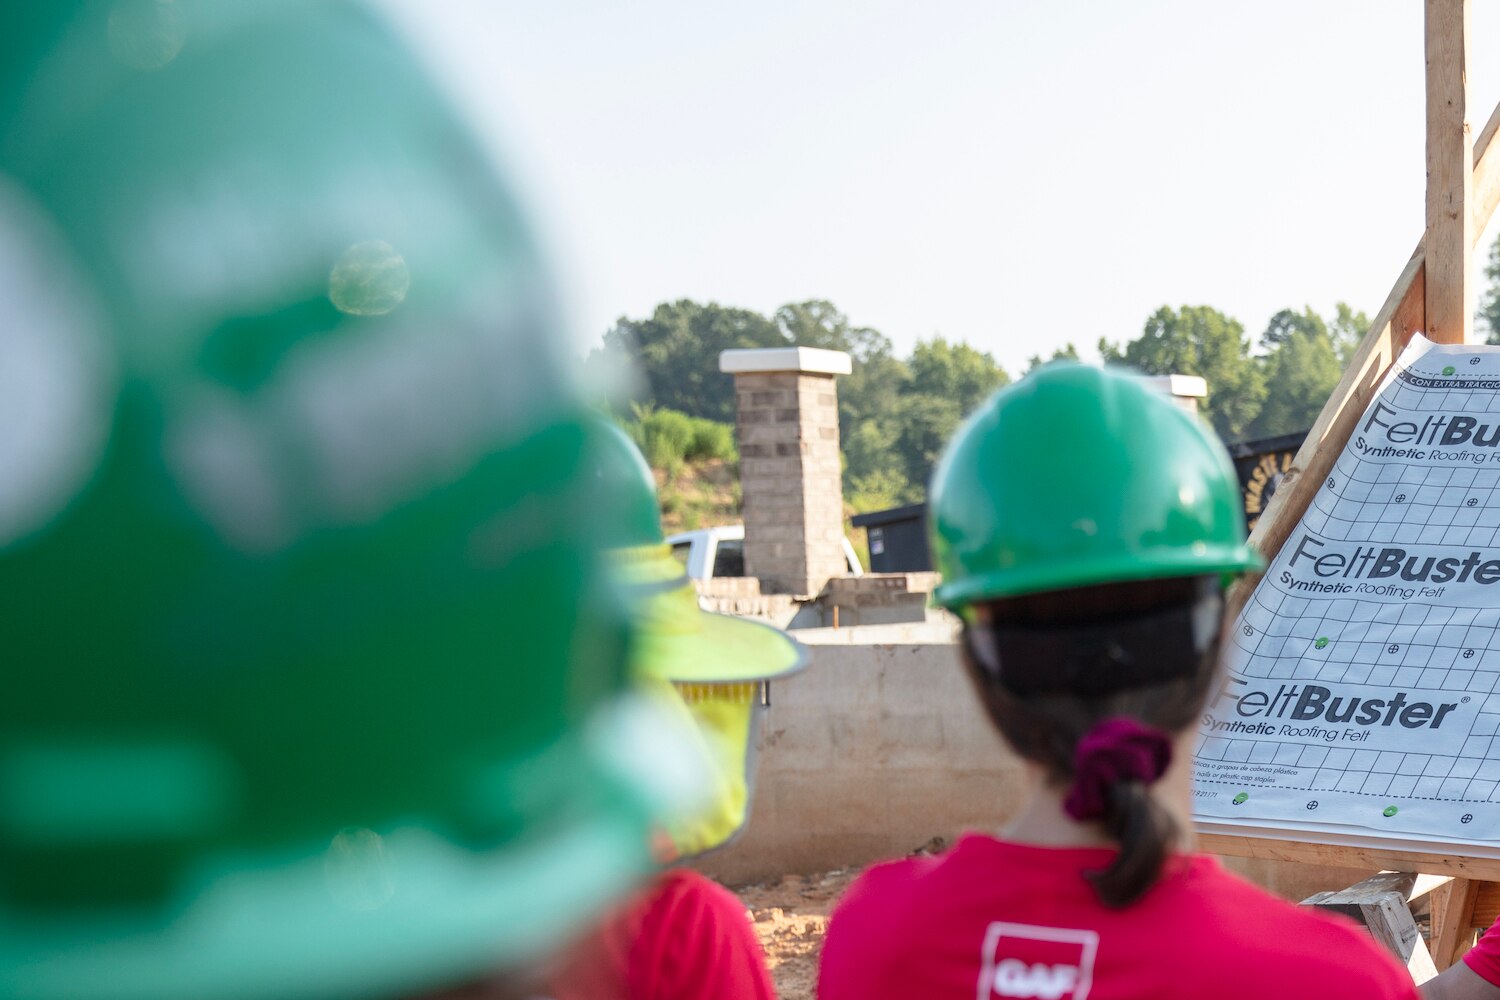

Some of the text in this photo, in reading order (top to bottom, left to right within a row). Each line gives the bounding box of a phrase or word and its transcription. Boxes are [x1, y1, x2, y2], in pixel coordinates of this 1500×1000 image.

[1410, 377, 1430, 387] CON
[1355, 436, 1426, 460] Synthetic
[1428, 450, 1486, 465] Roofing
[1280, 571, 1446, 600] Synthetic Roofing Felt
[1201, 713, 1371, 742] Synthetic Roofing Felt
[993, 957, 1080, 1000] GAF
